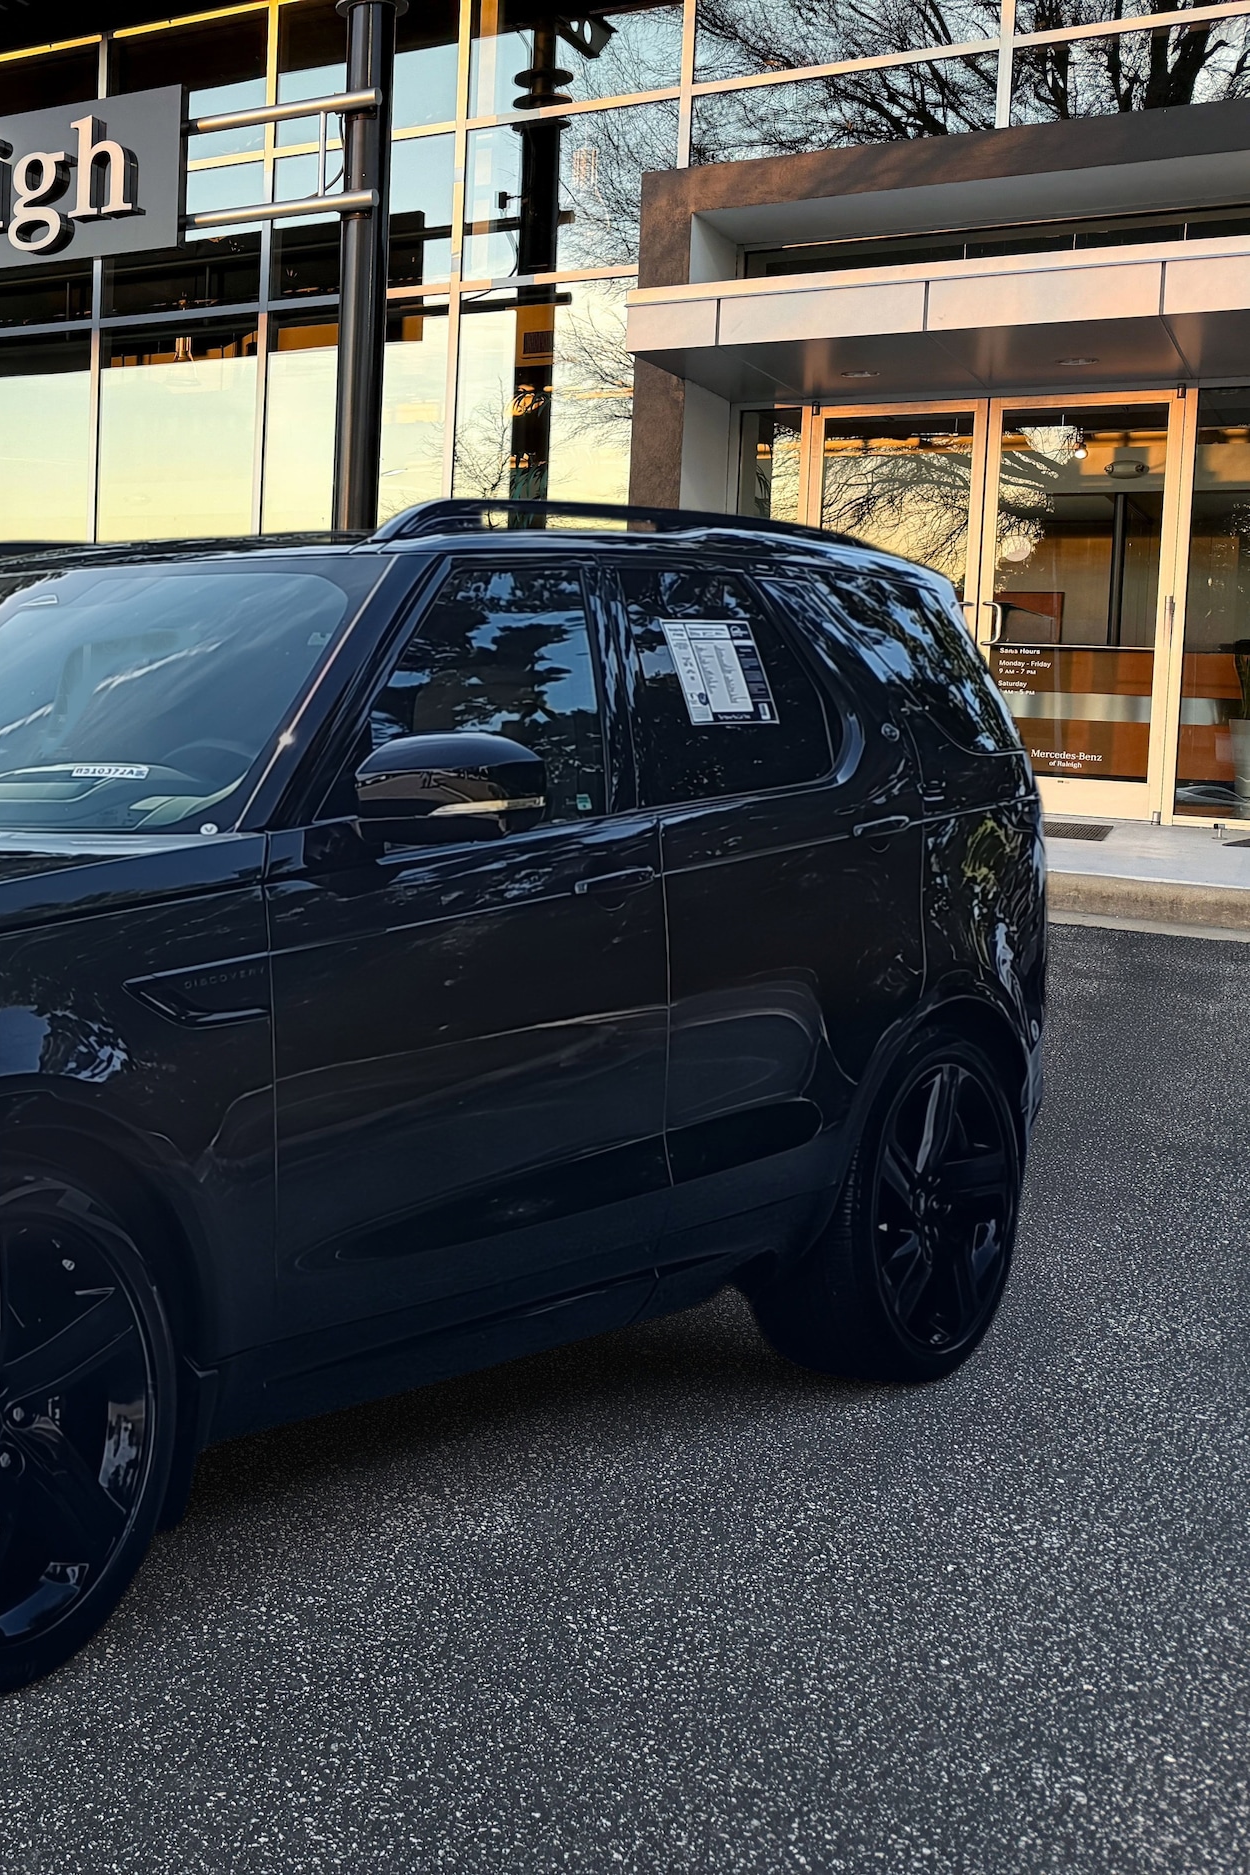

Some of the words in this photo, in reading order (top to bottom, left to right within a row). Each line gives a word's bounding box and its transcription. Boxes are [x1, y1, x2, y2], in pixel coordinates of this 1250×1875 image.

[1030, 661, 1051, 669] Friday
[998, 679, 1027, 688] Saturday
[1031, 749, 1103, 762] Mercedes-Benz
[1057, 761, 1083, 769] Raleigh
